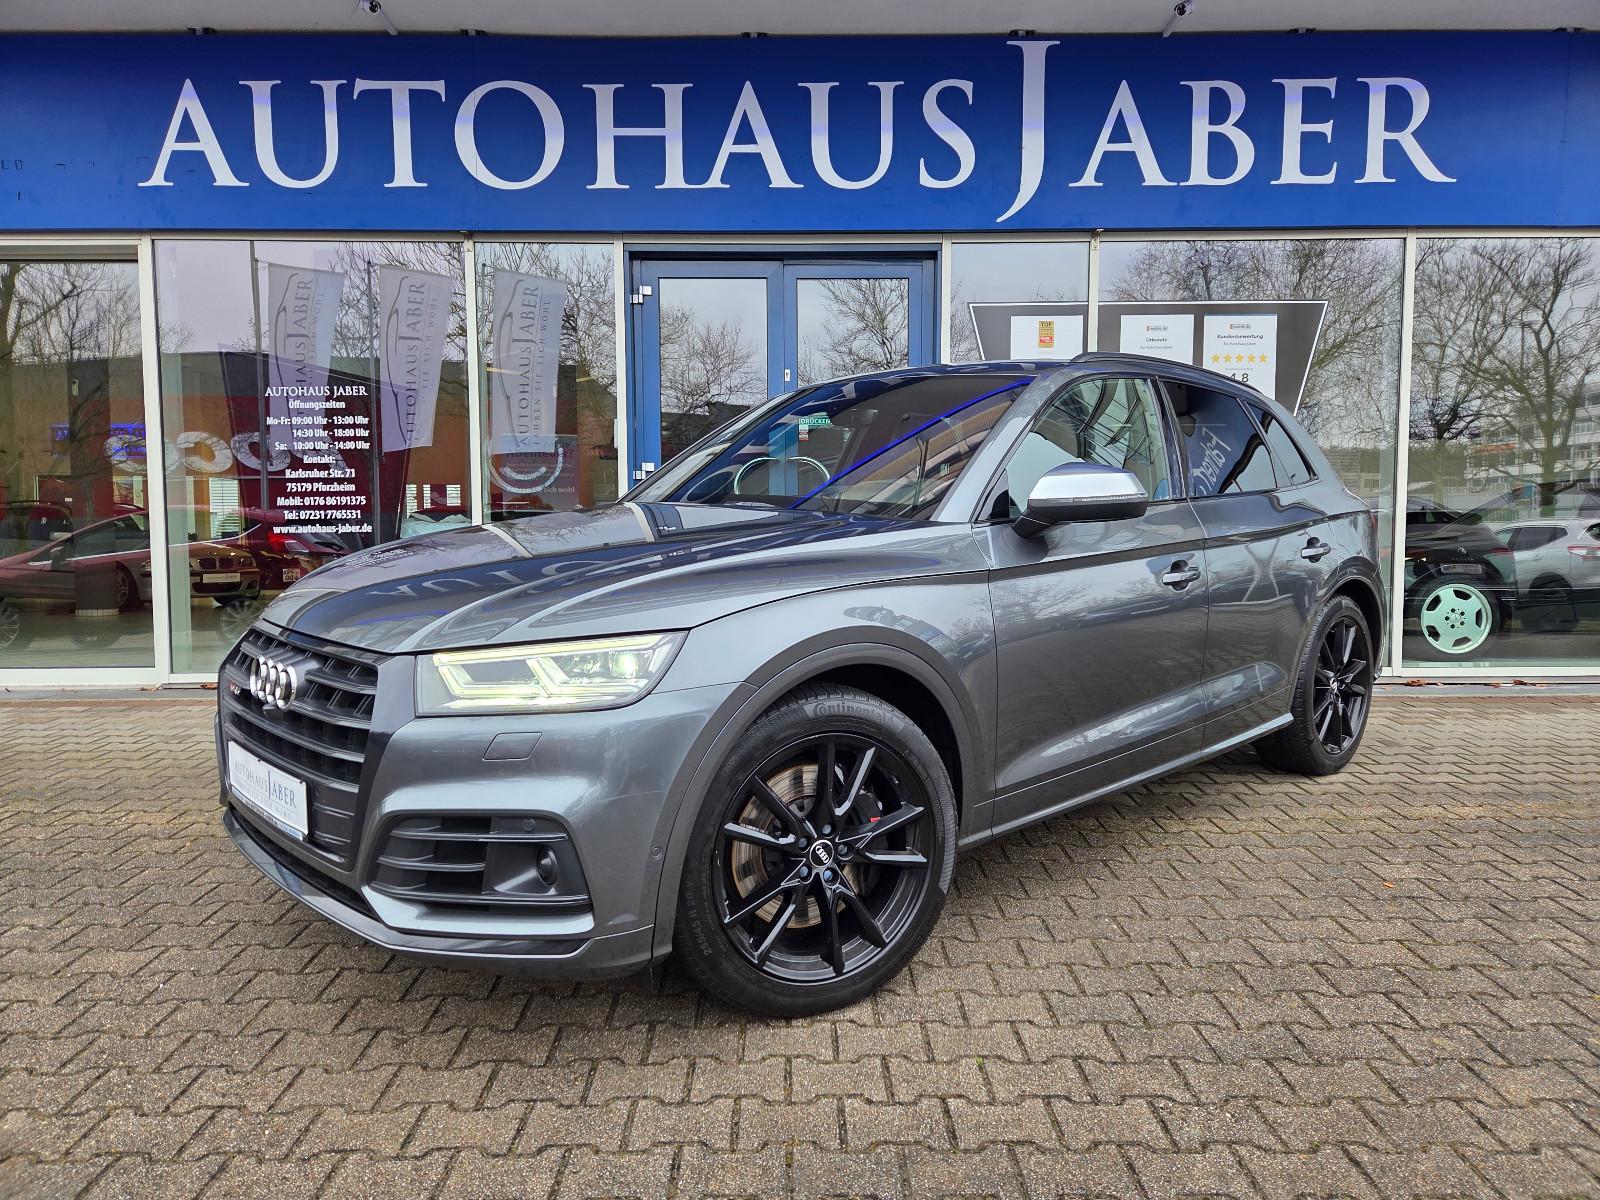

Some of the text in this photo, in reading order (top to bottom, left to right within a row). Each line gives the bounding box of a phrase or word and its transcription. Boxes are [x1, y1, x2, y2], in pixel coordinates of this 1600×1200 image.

[138, 40, 1457, 222] AUTOHAUS JABER
[398, 282, 425, 343] JABER
[512, 285, 539, 446] AUTOHAUS JABER
[265, 386, 368, 398] AUTOHAUS JABER
[288, 399, 346, 410] Öffnungszeiten
[266, 416, 291, 425] Mo-Fr:
[291, 416, 312, 425] 09:00
[314, 416, 328, 425] Uhr
[333, 416, 354, 425] 13:00
[355, 416, 369, 425] Uhr
[292, 429, 313, 437] 14:30
[314, 429, 328, 437] Uhr
[334, 429, 354, 437] 18:00
[355, 428, 369, 437] Uhr
[274, 442, 287, 450] Sa:
[293, 441, 314, 450] 10:00
[315, 441, 329, 449] Uhr
[335, 441, 355, 449] 14:00
[356, 440, 370, 449] Uhr
[303, 455, 336, 464] Kontakt:
[285, 469, 355, 479] Karlsruher Str. 71
[286, 482, 356, 492] 75179 Pforzheim
[276, 496, 366, 506] Mobil: 0176 86191375
[283, 510, 361, 520] Tel: 07231 7765531
[273, 524, 373, 535] www.autohaus-jaber.de
[267, 769, 297, 809] JABER
